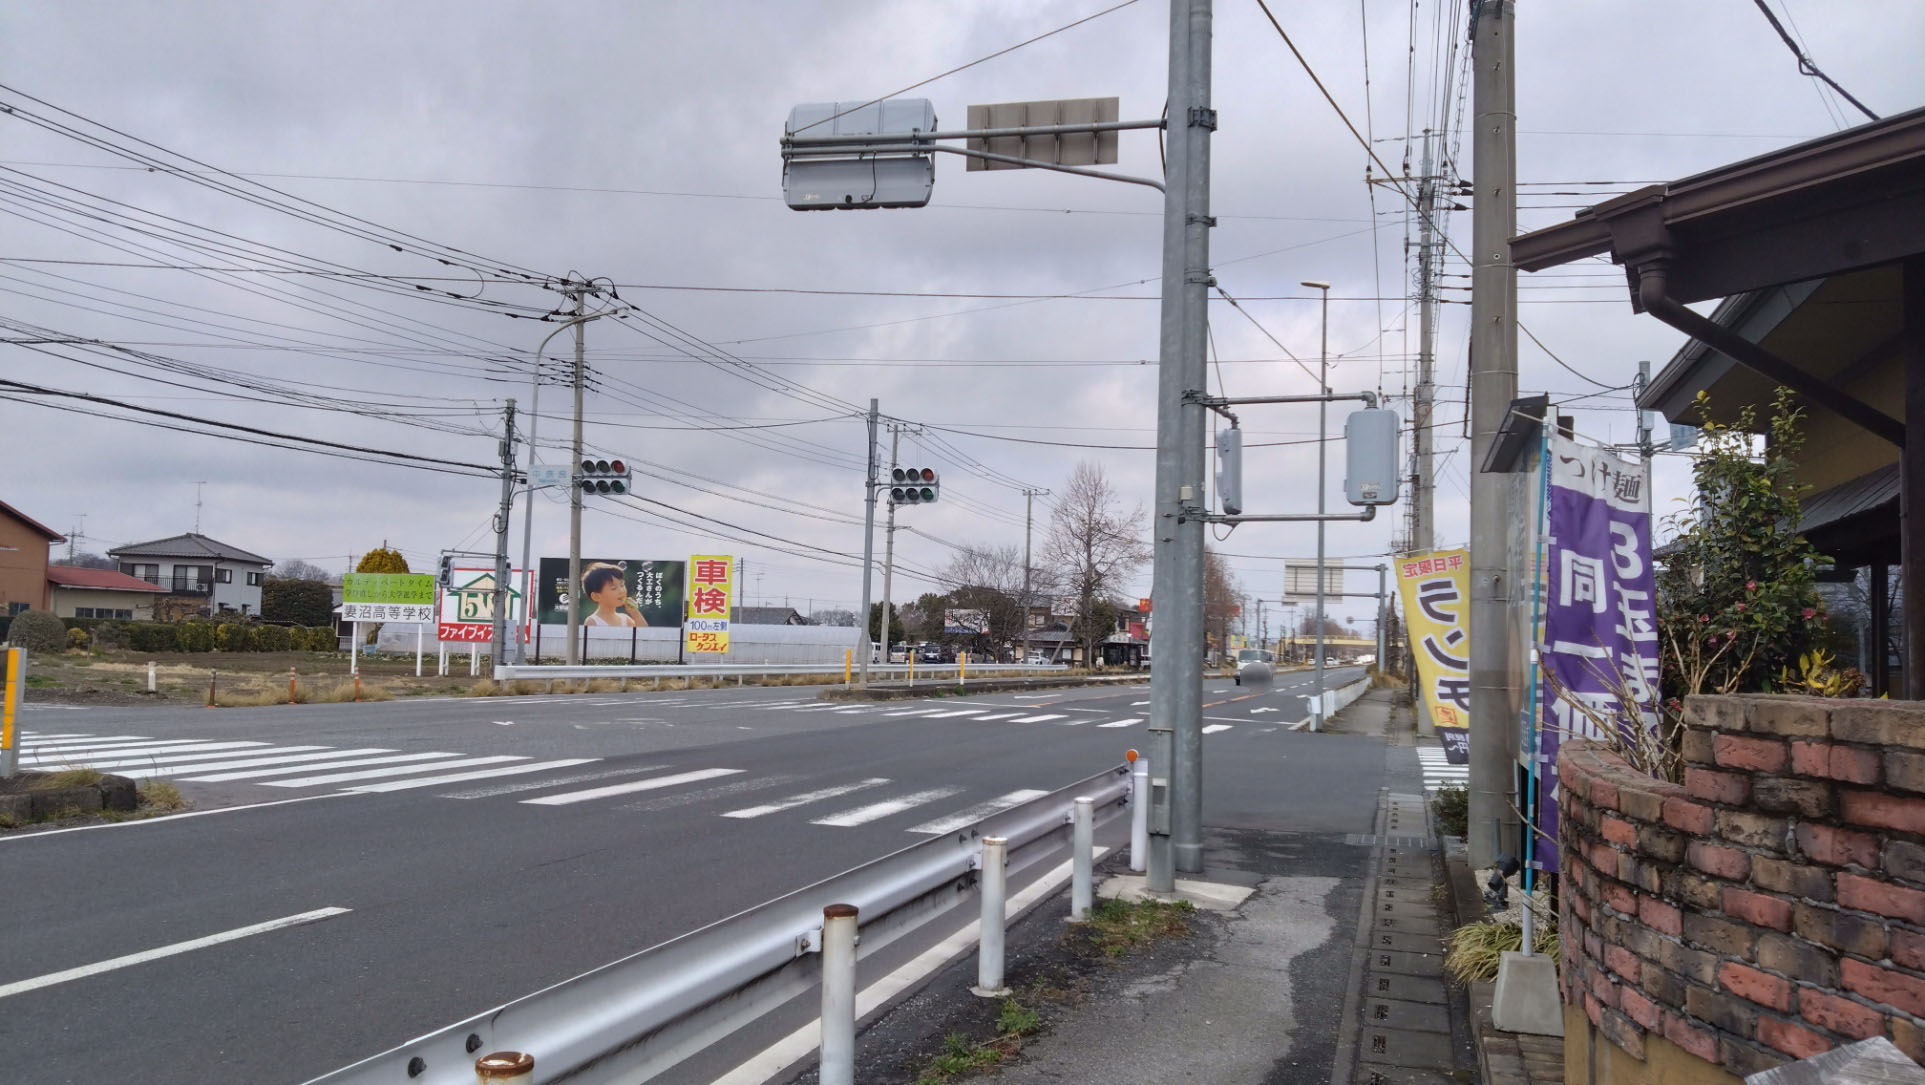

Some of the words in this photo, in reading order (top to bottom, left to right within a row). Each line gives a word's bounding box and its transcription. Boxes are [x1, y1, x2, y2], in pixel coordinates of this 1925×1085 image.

[1560, 455, 1642, 504] つけ麺
[645, 571, 653, 605] 大工さんが
[694, 559, 728, 614] 車検
[344, 604, 432, 620] 妻沼高等学校
[690, 633, 717, 641] ロータス
